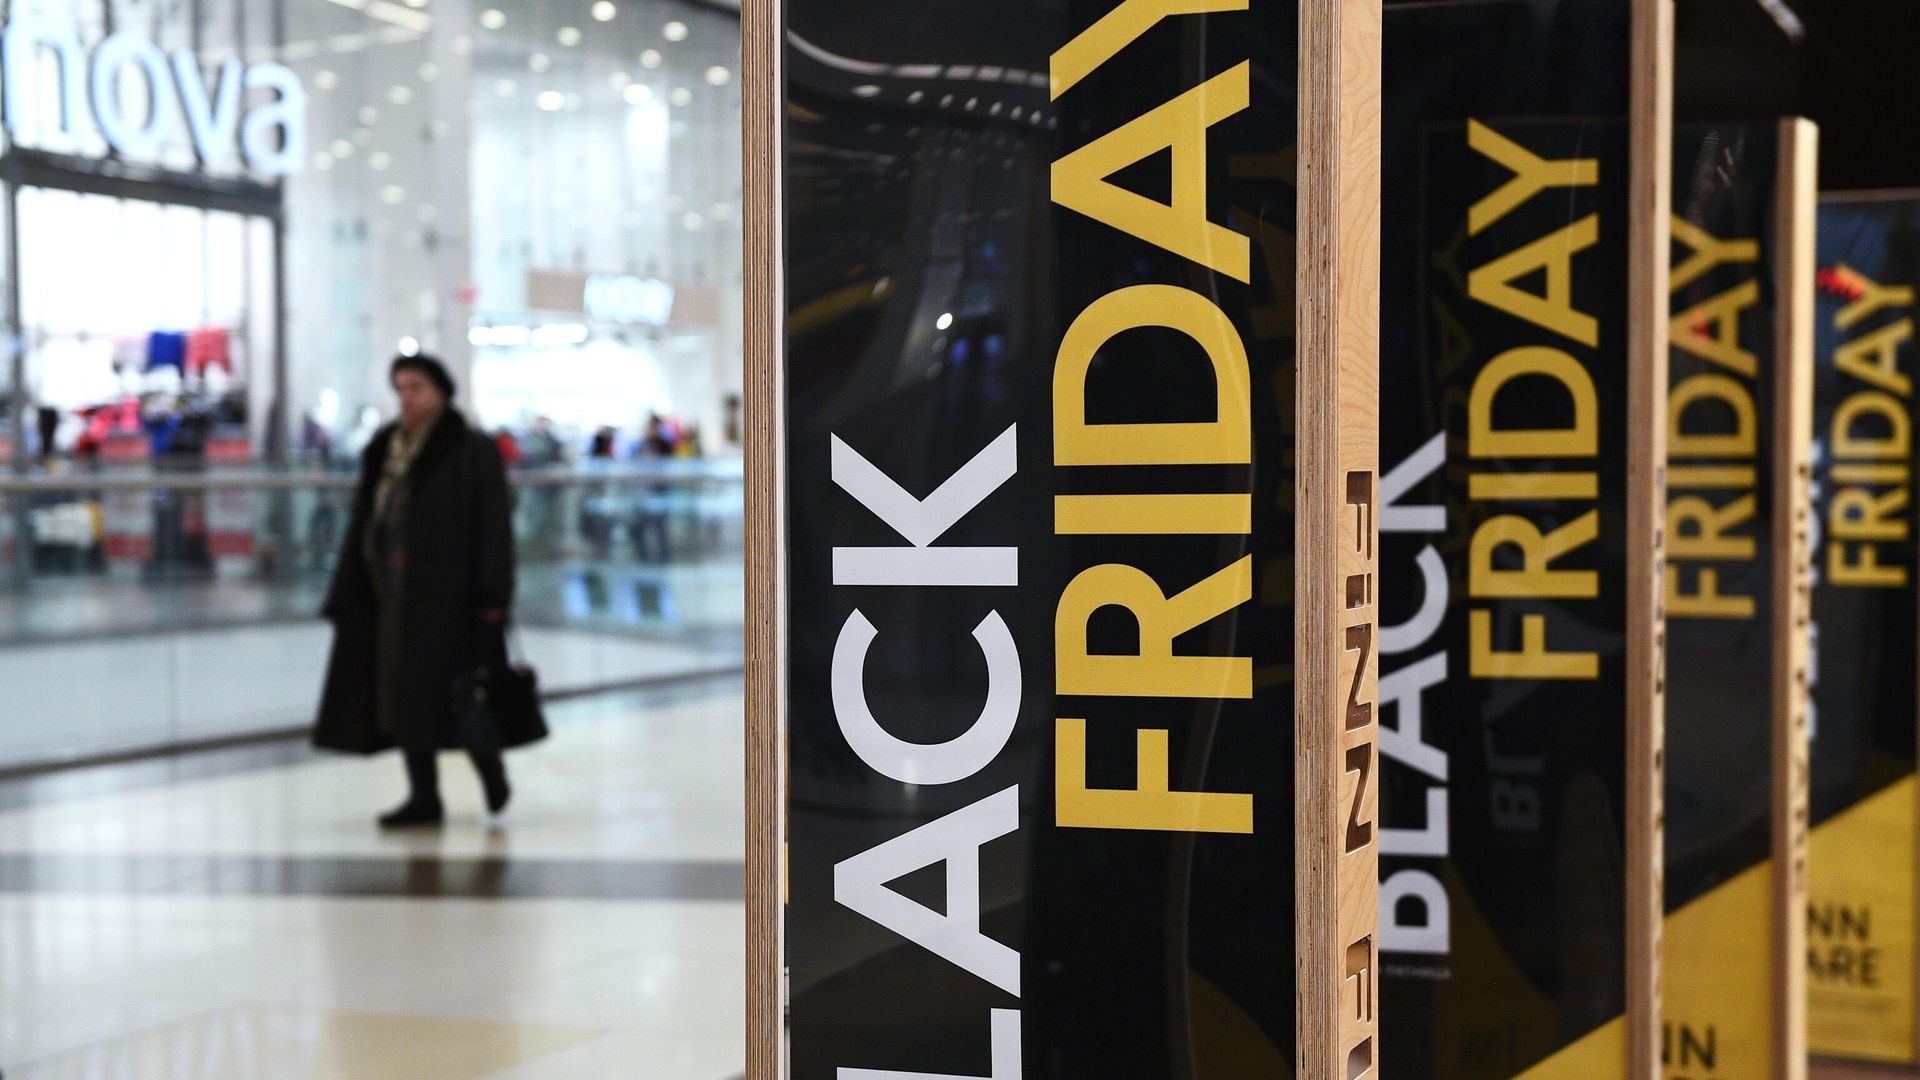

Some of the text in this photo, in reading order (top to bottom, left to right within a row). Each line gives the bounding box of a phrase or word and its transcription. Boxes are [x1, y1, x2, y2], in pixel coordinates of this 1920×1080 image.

[1468, 118, 1599, 679] FRIDAY
[1664, 214, 1760, 619] FRIDAY
[1828, 263, 1915, 587] FRIDAY
